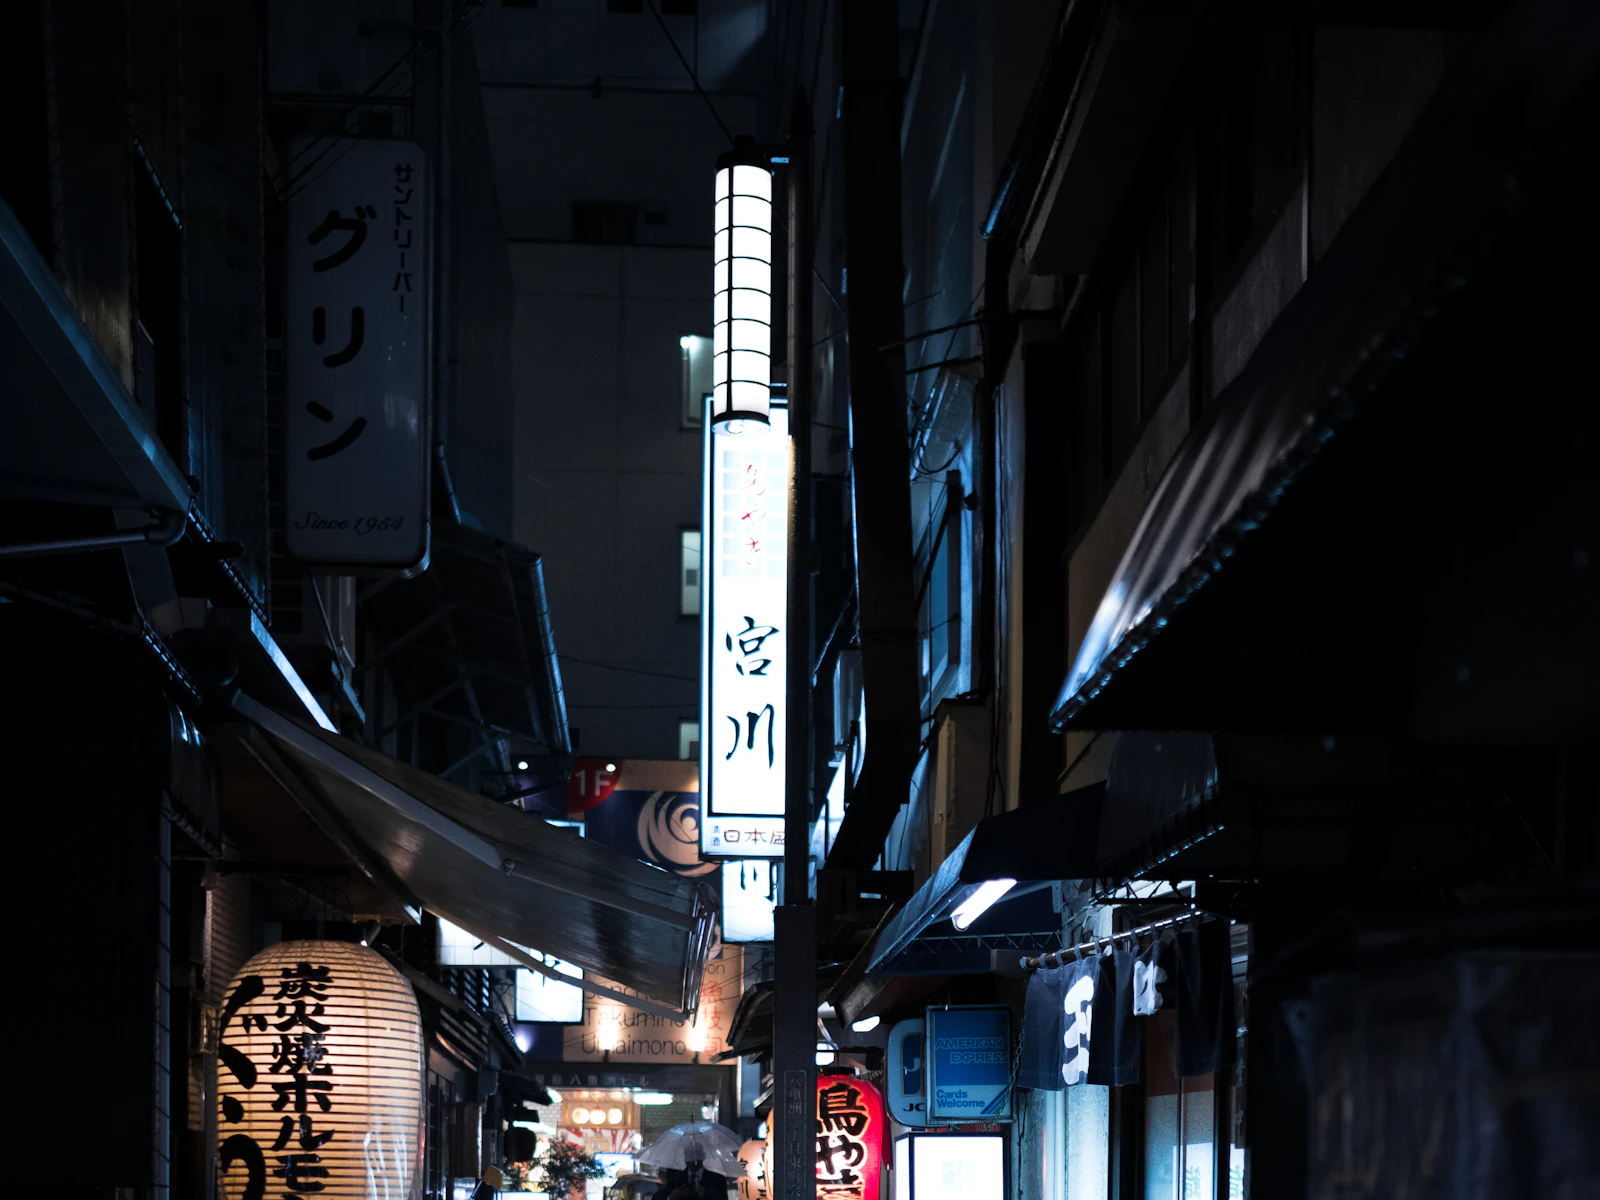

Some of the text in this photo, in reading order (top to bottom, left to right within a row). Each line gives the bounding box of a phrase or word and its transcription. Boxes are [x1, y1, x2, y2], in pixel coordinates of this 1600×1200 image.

[392, 162, 414, 313] サントリーバー
[306, 204, 378, 462] グリン
[294, 511, 350, 530] Since
[725, 615, 780, 769] 宮川
[575, 769, 614, 797] 1F
[582, 1034, 686, 1056] Uaimono
[935, 1036, 1005, 1050] AMERICAN
[950, 1051, 1011, 1064] EXPRESS
[936, 1089, 968, 1099] Cards
[936, 1098, 986, 1108] Welcome
